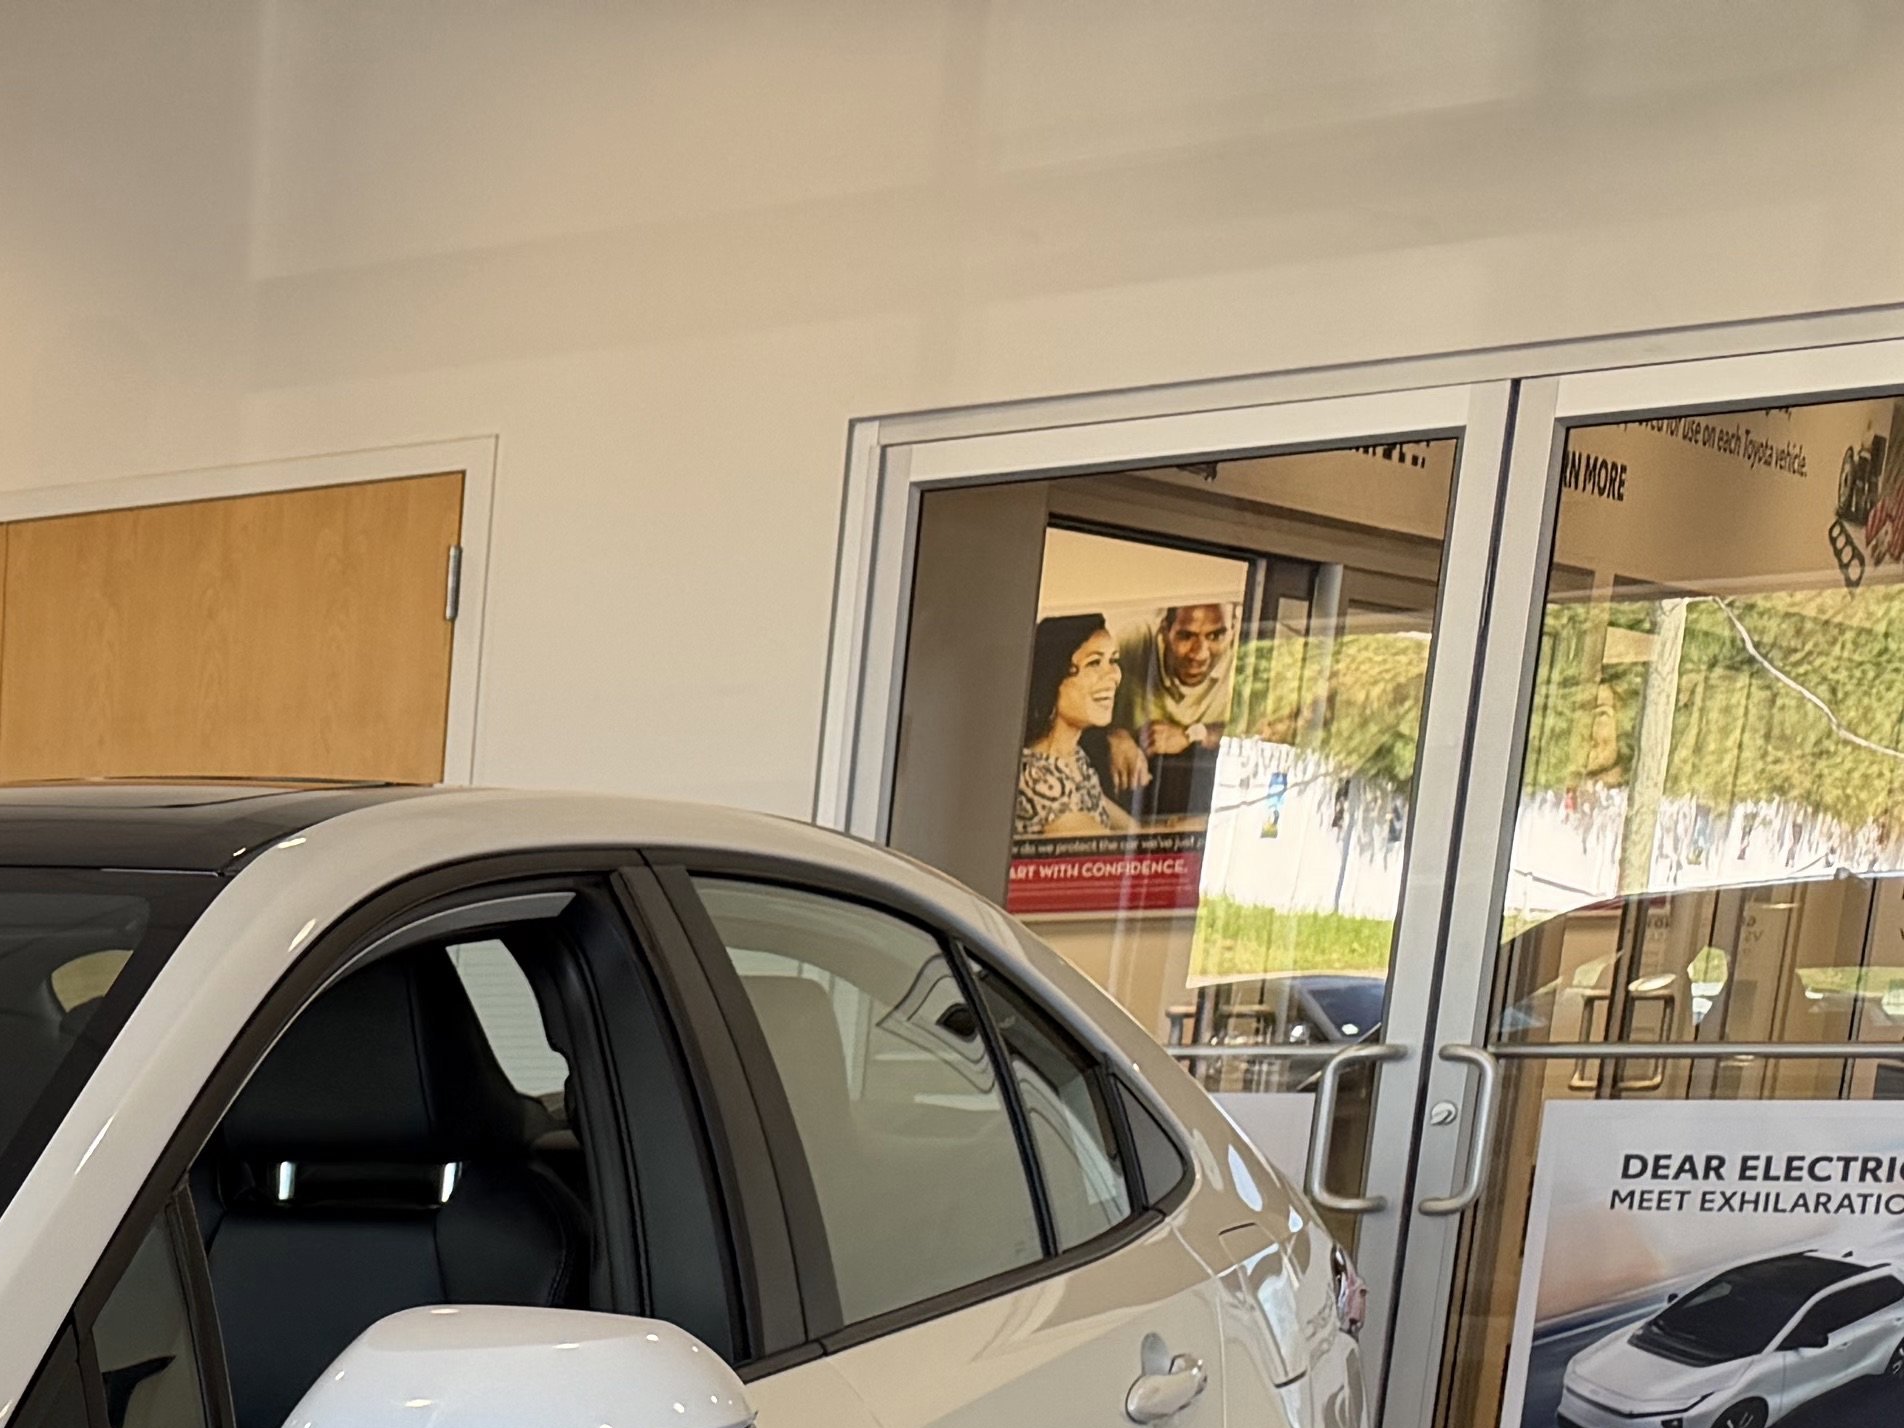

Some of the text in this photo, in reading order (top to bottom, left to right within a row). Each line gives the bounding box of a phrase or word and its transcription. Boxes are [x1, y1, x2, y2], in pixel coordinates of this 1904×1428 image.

[1703, 424, 1716, 448] on
[1717, 424, 1741, 456] each
[1741, 428, 1773, 470] Toyota
[1774, 441, 1808, 477] vehicle.
[1582, 453, 1627, 501] MORE
[1039, 862, 1079, 879] WITH
[1082, 859, 1188, 877] CONFIDENCE.
[1620, 1154, 1904, 1183] DEAR ELECTRI
[1610, 1190, 1904, 1215] MEET EXHILARATIO
